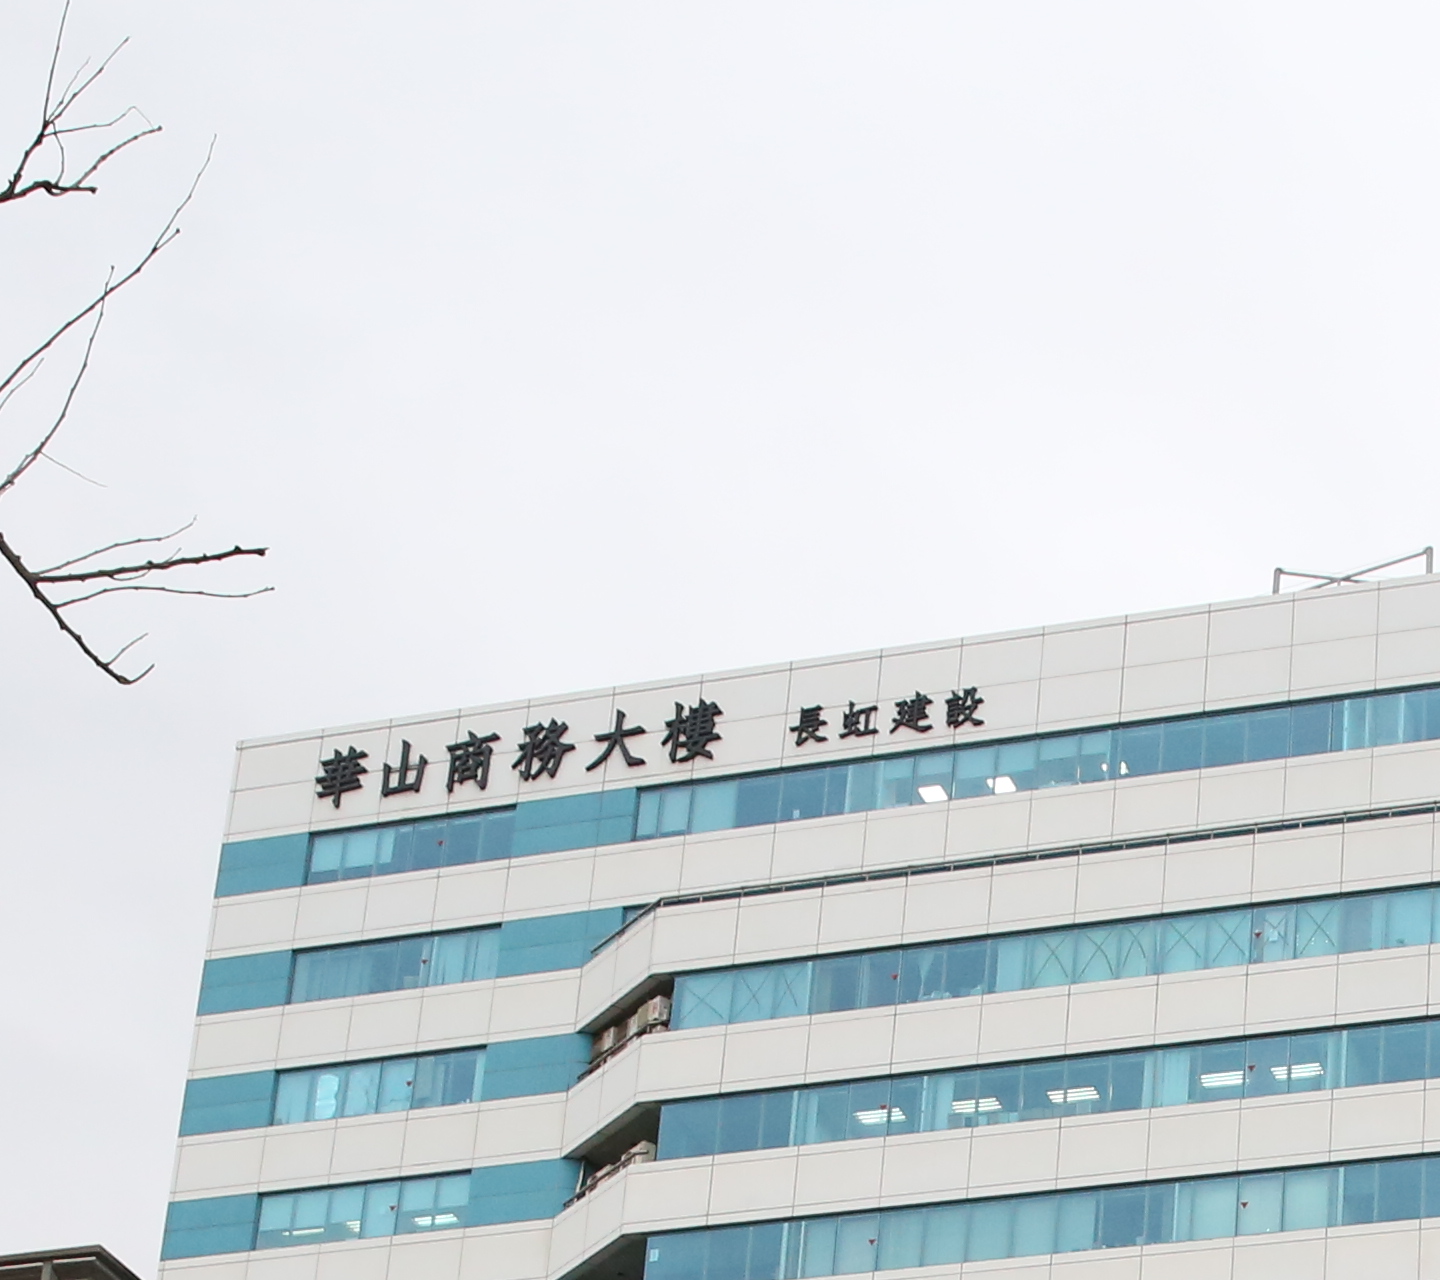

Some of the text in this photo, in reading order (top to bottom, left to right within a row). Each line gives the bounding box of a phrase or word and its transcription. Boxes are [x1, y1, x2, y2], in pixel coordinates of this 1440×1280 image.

[315, 698, 724, 809] 華山商務大樓
[789, 687, 986, 747] 長虹建設
